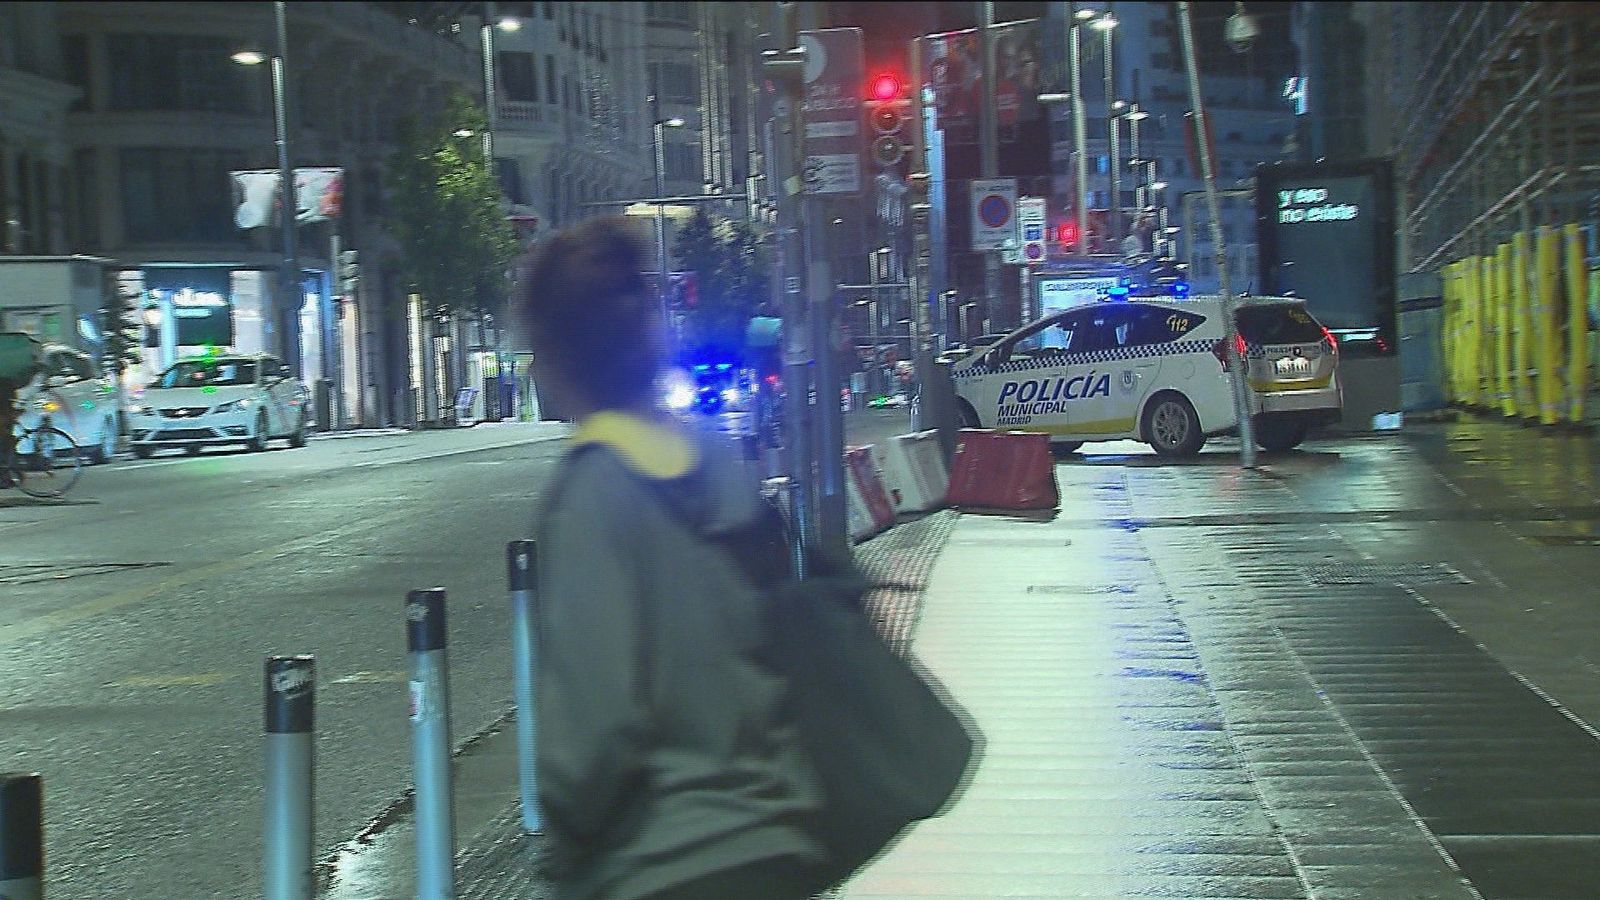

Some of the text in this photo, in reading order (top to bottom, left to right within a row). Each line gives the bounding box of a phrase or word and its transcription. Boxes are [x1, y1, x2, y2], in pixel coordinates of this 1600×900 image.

[1170, 318, 1188, 331] 112
[998, 371, 1111, 404] POLICÍA
[998, 401, 1067, 417] MUNICIPAL
[997, 416, 1032, 426] MADRID
